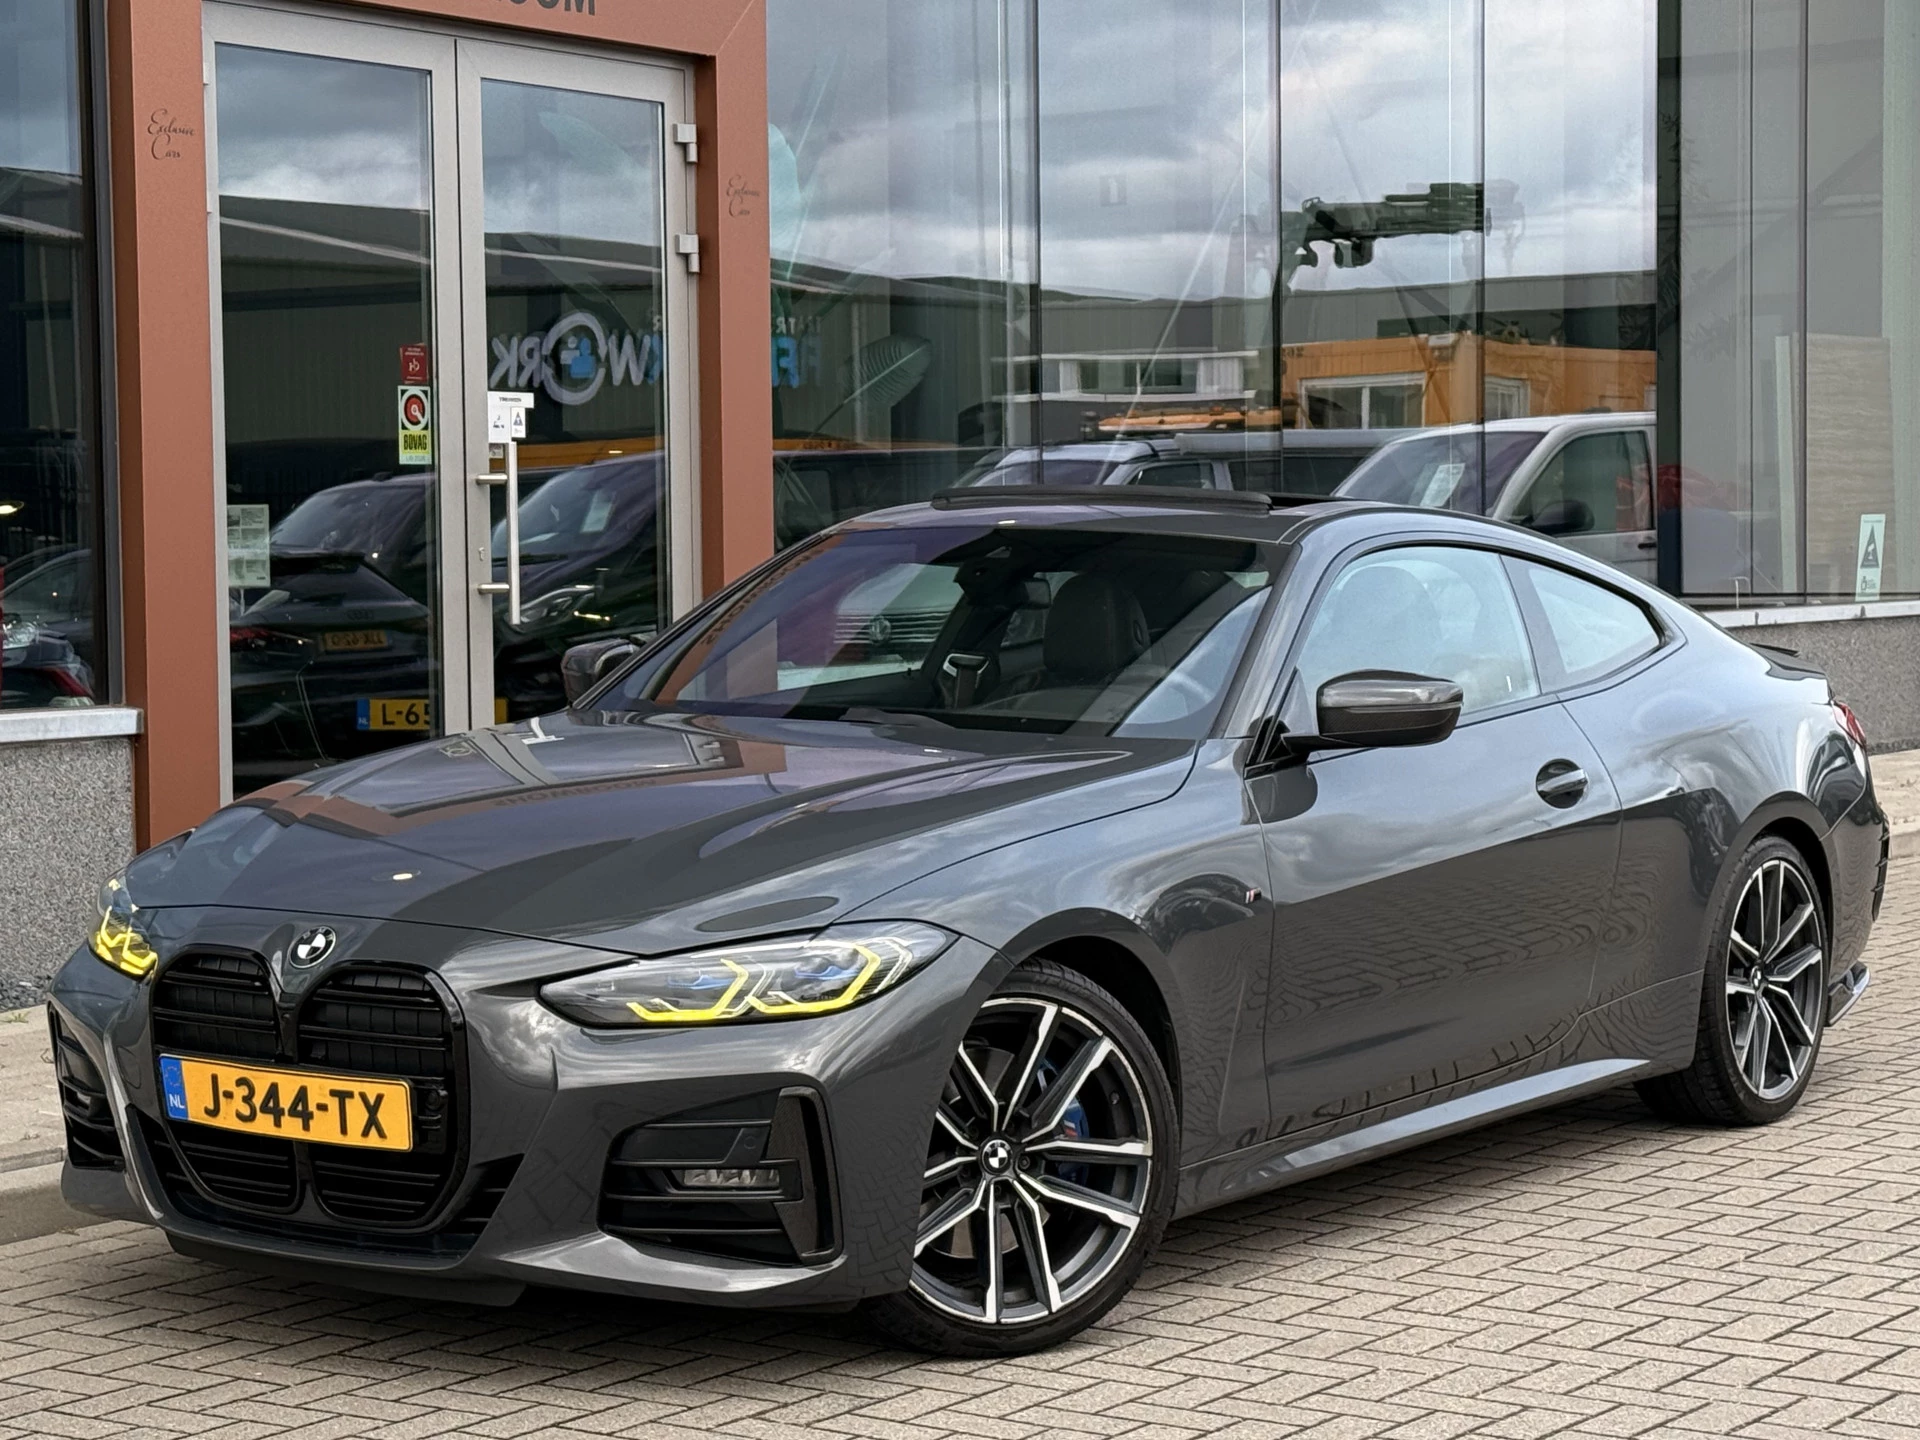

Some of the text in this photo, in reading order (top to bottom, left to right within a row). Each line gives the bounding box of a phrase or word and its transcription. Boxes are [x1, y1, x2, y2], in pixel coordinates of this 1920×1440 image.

[151, 133, 181, 160] Cars
[403, 433, 428, 451] BOVAG
[168, 1094, 186, 1110] NL
[203, 1073, 388, 1140] J-344-TX
